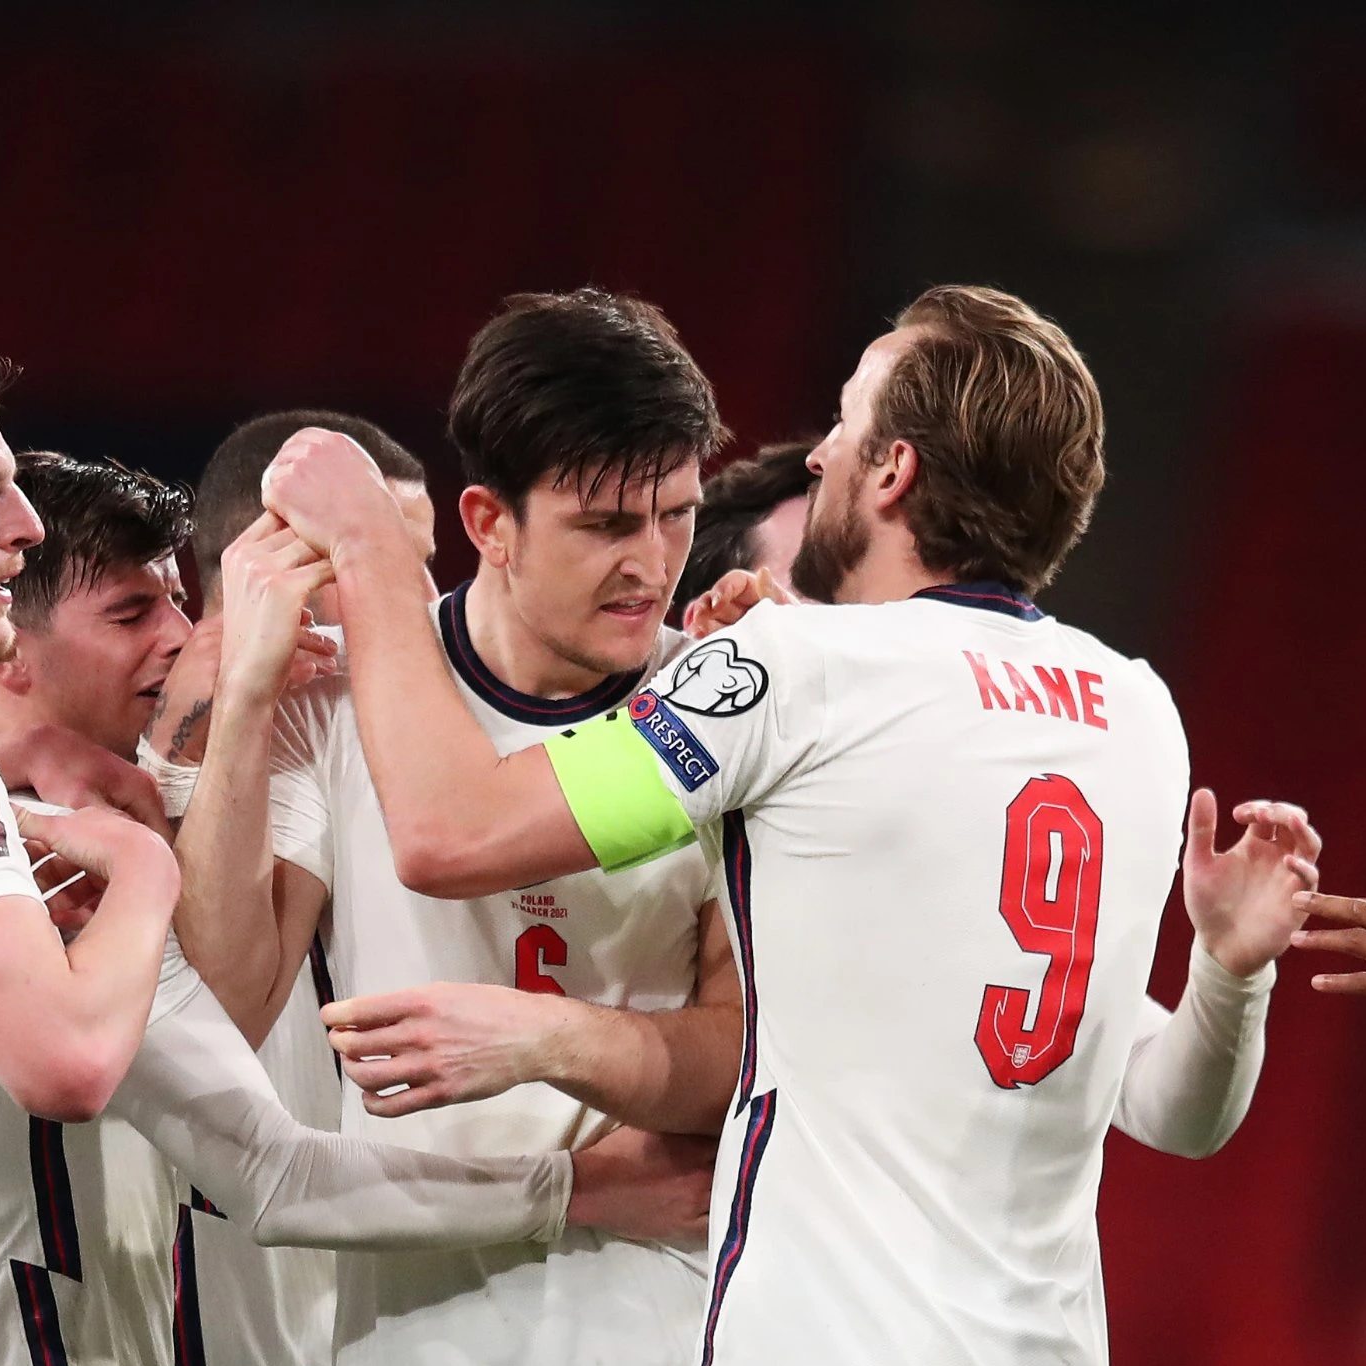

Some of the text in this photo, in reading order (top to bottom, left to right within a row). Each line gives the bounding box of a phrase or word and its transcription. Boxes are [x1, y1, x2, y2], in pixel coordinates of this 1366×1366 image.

[962, 650, 1109, 731] KANE
[646, 711, 710, 782] RESPECT
[519, 905, 549, 918] MARCH
[550, 908, 568, 919] 2021
[520, 894, 555, 906] POLAND
[973, 773, 1103, 1089] 9
[515, 923, 567, 998] 6
